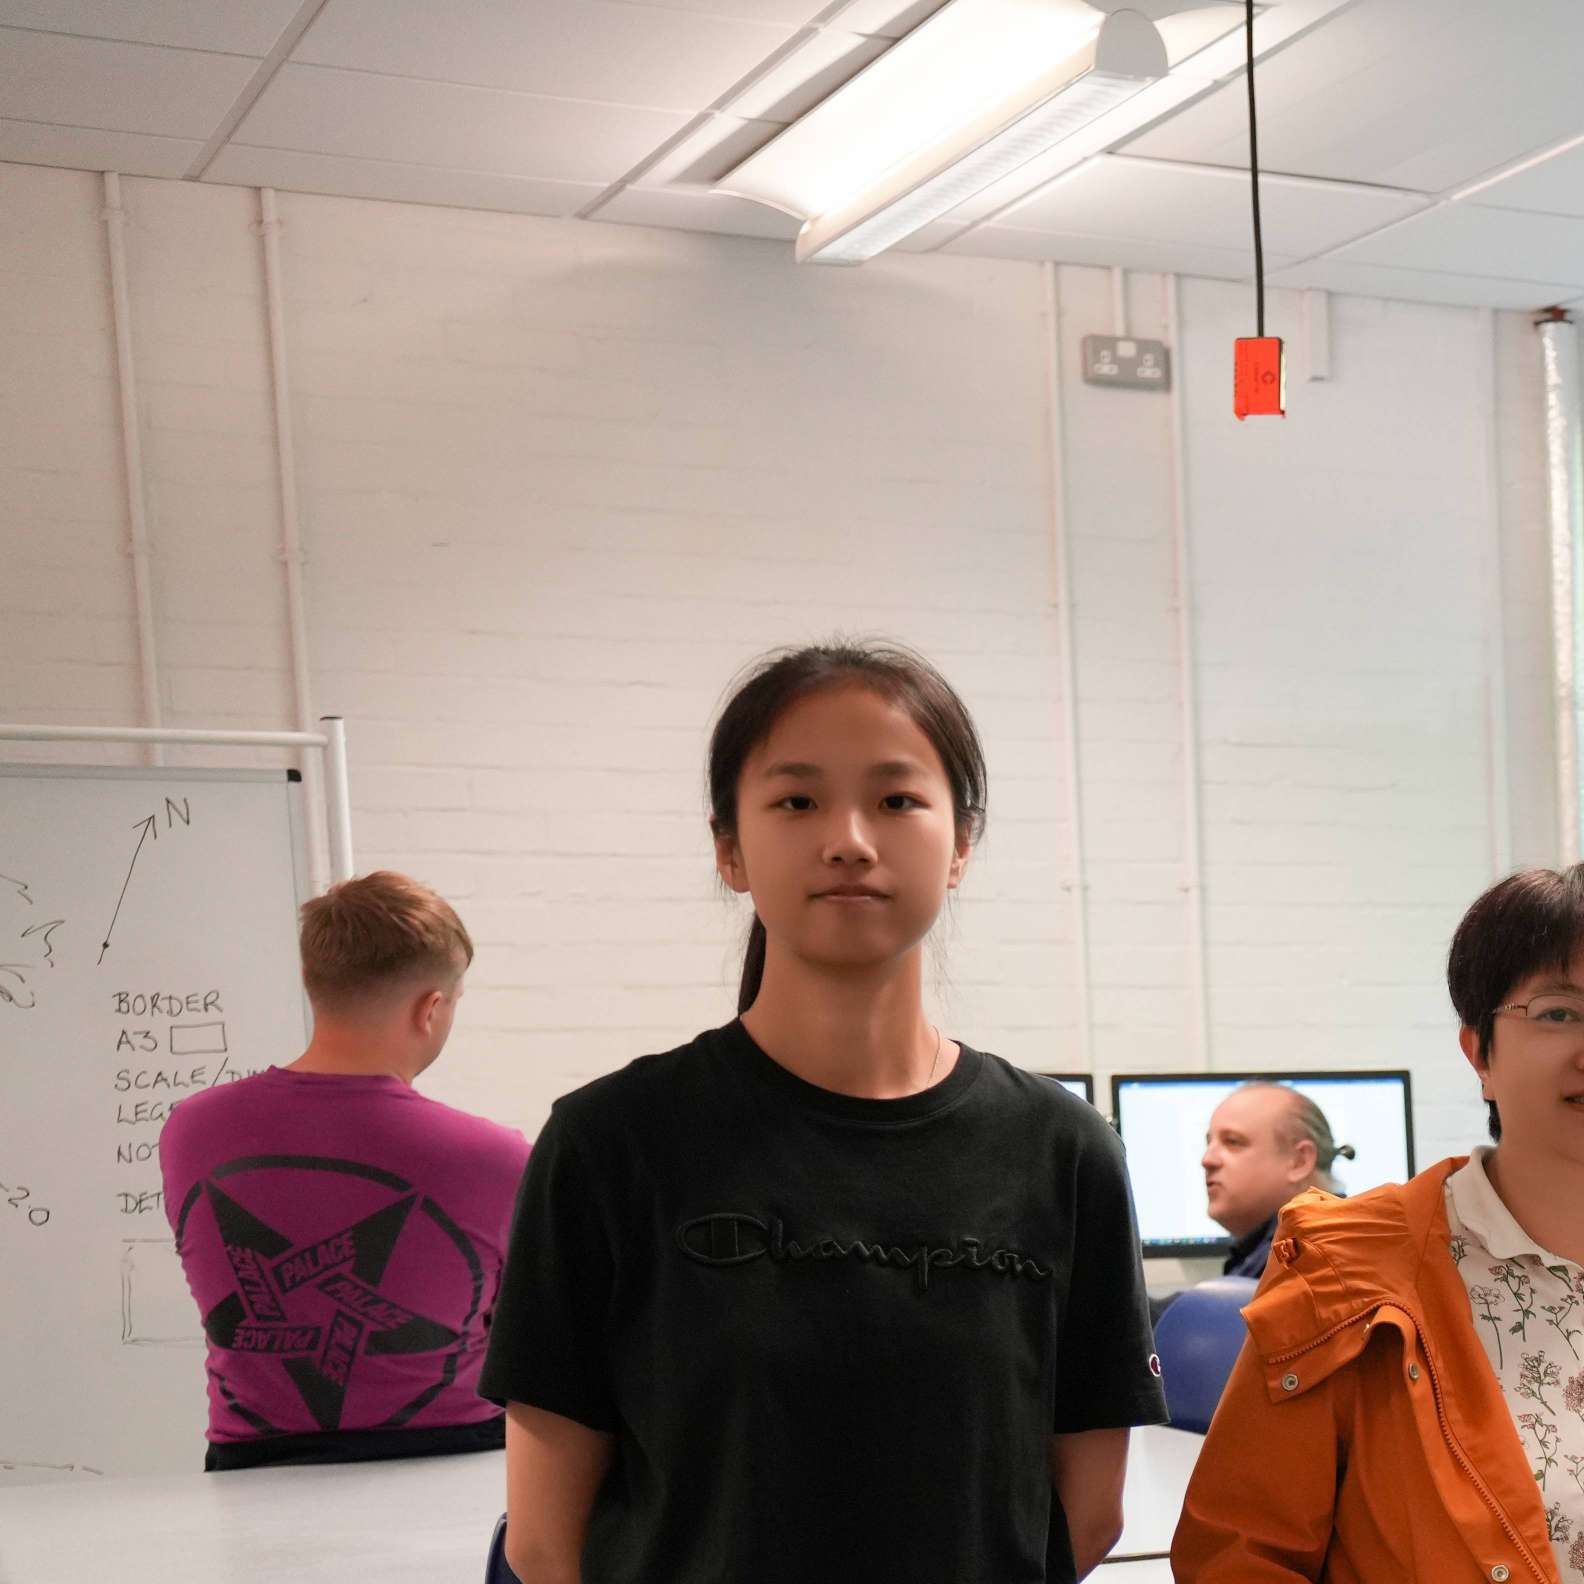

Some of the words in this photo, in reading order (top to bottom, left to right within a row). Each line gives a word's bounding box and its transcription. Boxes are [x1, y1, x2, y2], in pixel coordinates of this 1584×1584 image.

[165, 797, 190, 828] N
[112, 990, 223, 1017] BORDER
[116, 1029, 158, 1052] A3
[279, 1231, 357, 1286] PALACE
[675, 1212, 1054, 1290] Champion
